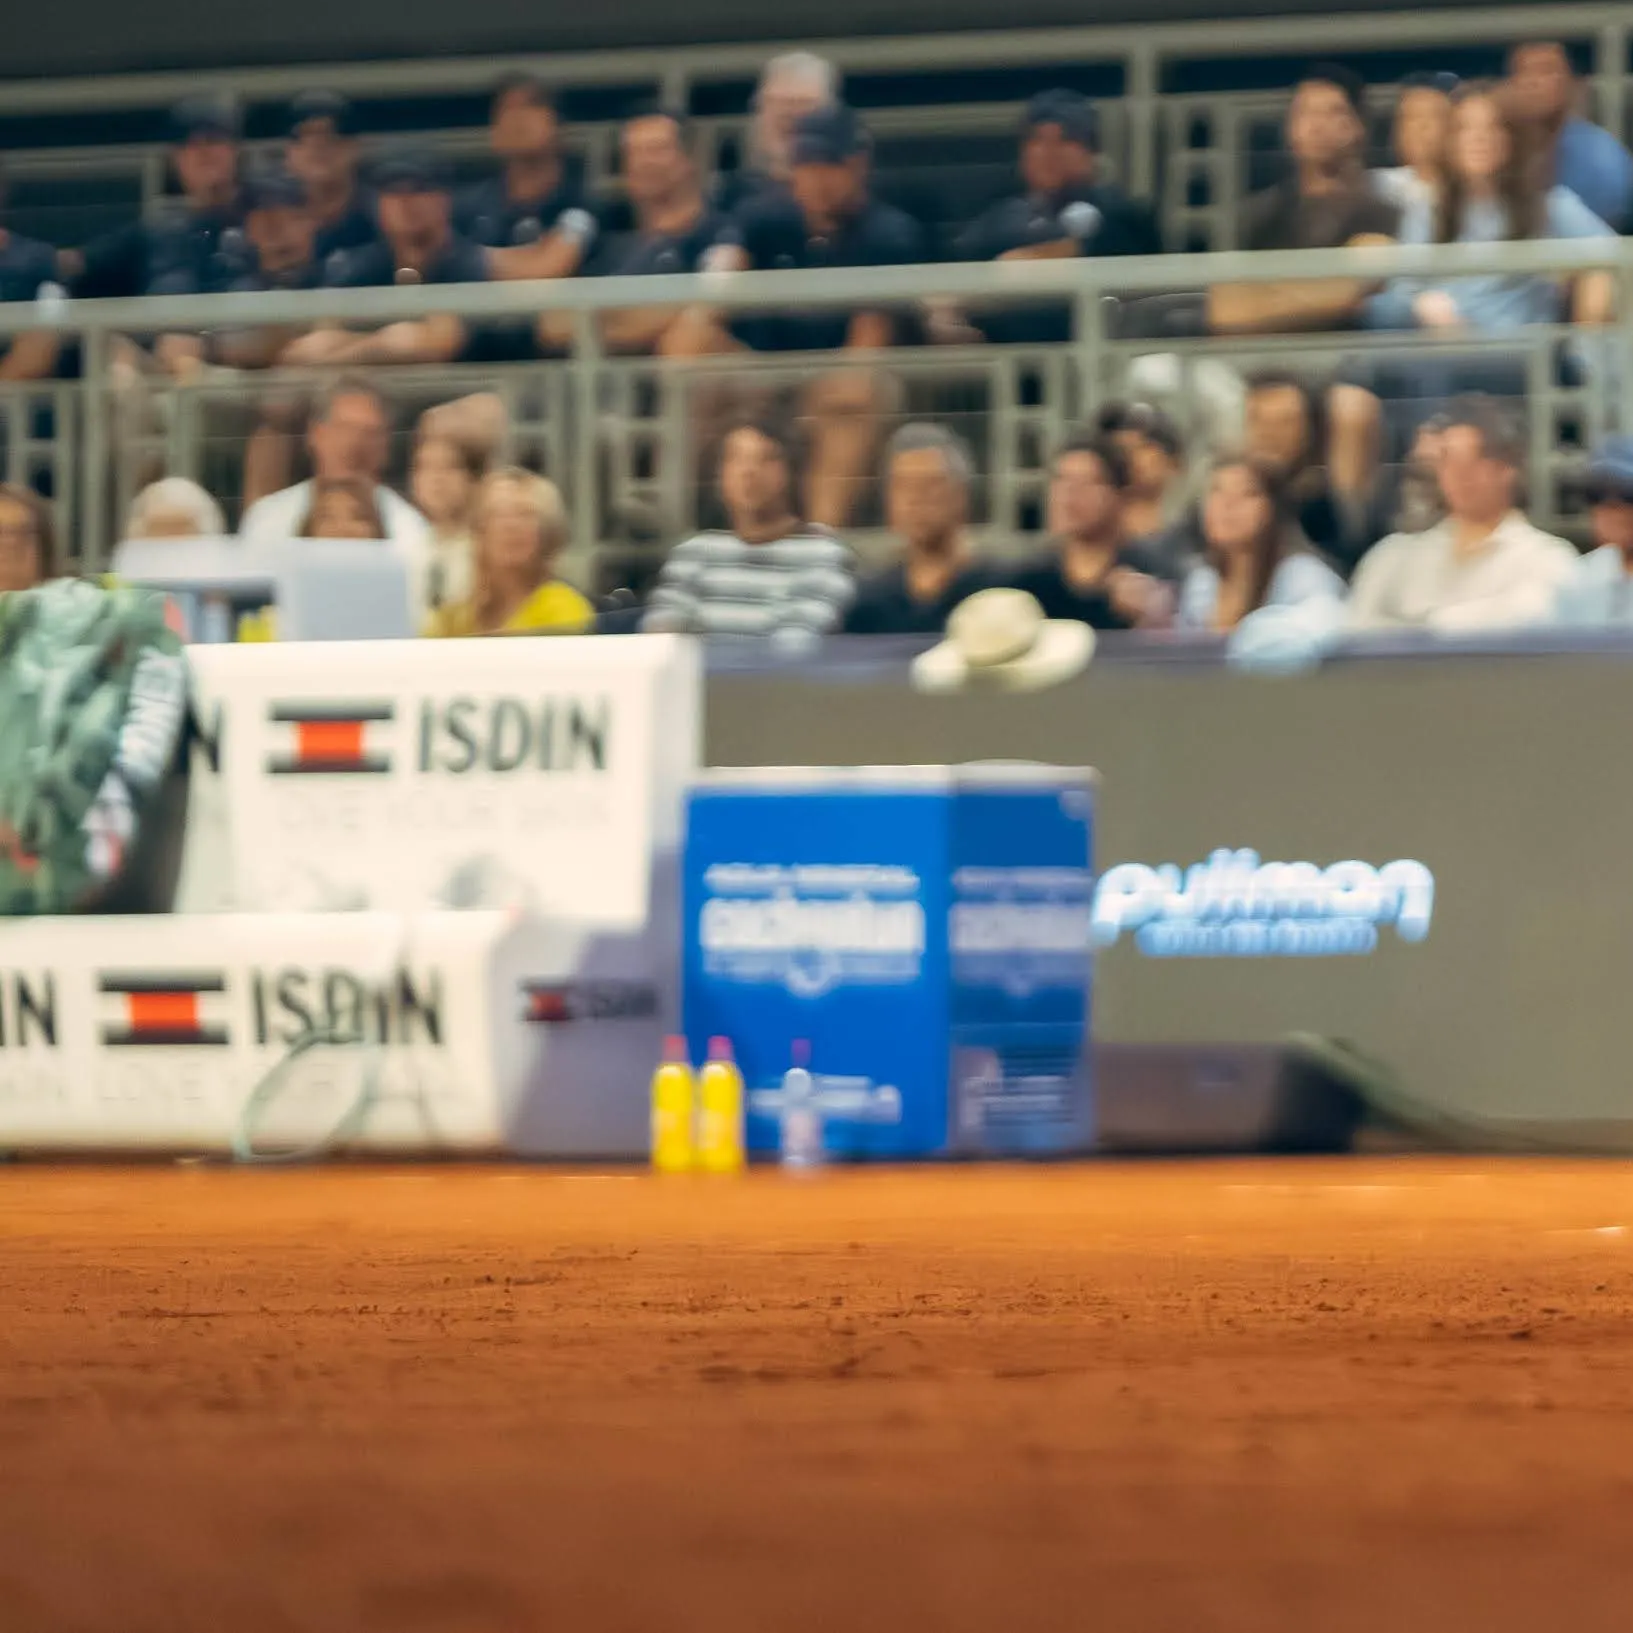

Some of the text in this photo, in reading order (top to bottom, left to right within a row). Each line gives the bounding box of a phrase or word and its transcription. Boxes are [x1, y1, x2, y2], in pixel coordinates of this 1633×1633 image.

[416, 694, 608, 774] ISDIN
[1089, 846, 1435, 946] pullman
[251, 966, 444, 1046] ISDIN
